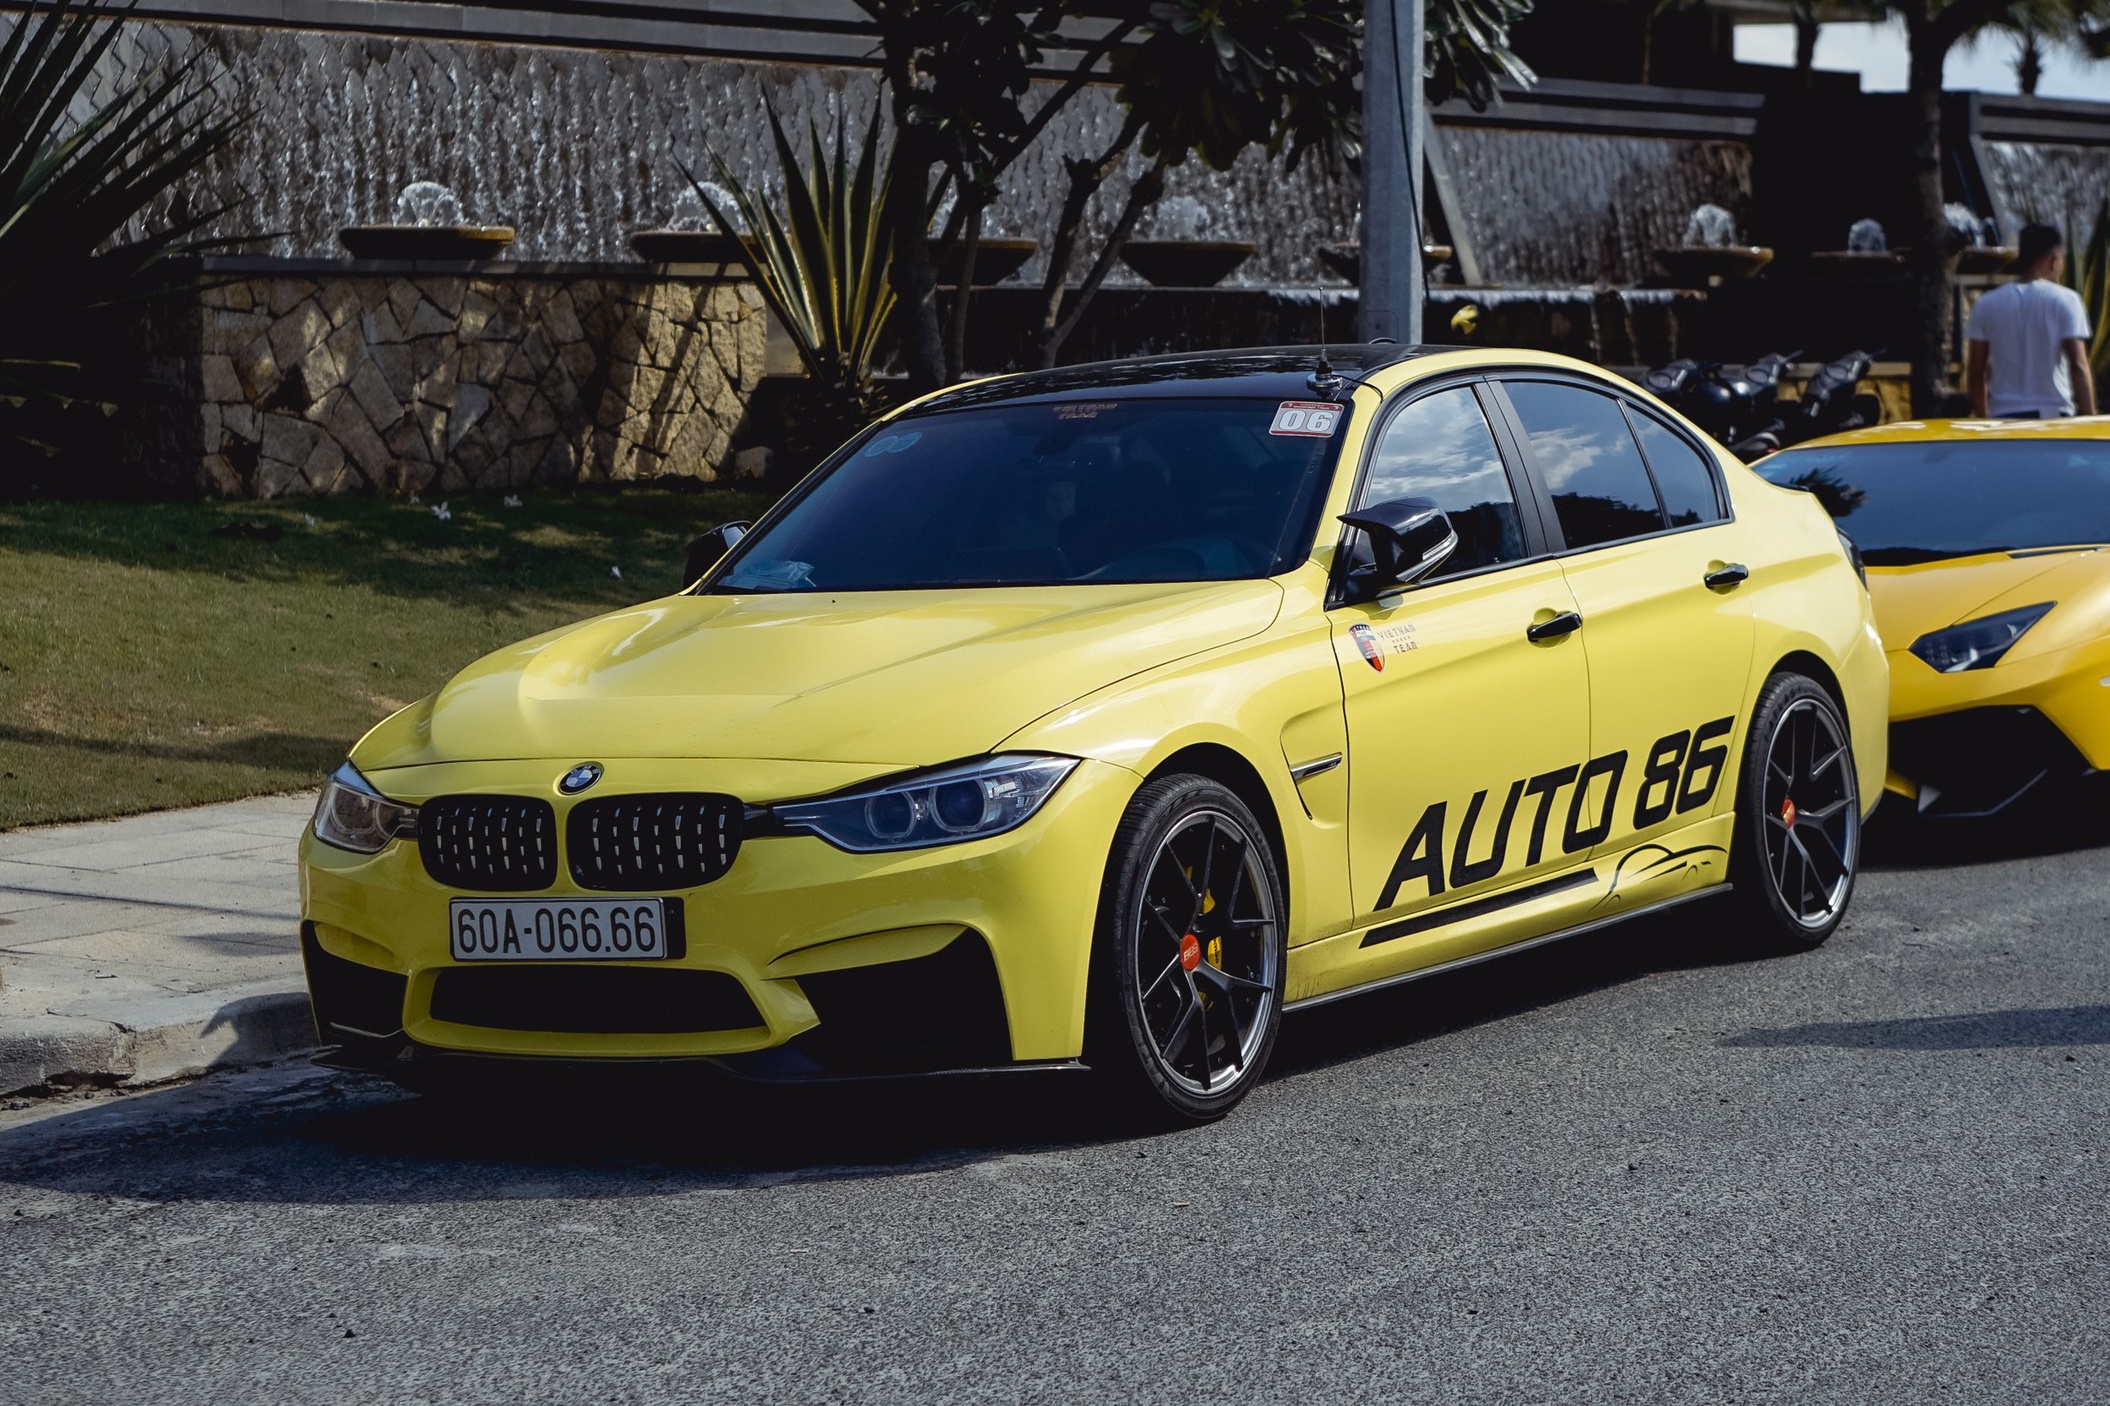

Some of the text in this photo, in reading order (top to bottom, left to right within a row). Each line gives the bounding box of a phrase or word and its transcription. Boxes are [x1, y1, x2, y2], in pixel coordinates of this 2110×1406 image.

[1278, 410, 1334, 432] 06
[1377, 624, 1417, 640] VIETNAM
[1393, 641, 1418, 654] TEAM
[1372, 749, 1629, 912] AUTO
[1632, 714, 1736, 831] 86
[457, 905, 657, 954] 60A-066.66
[1183, 939, 1199, 962] BBS
